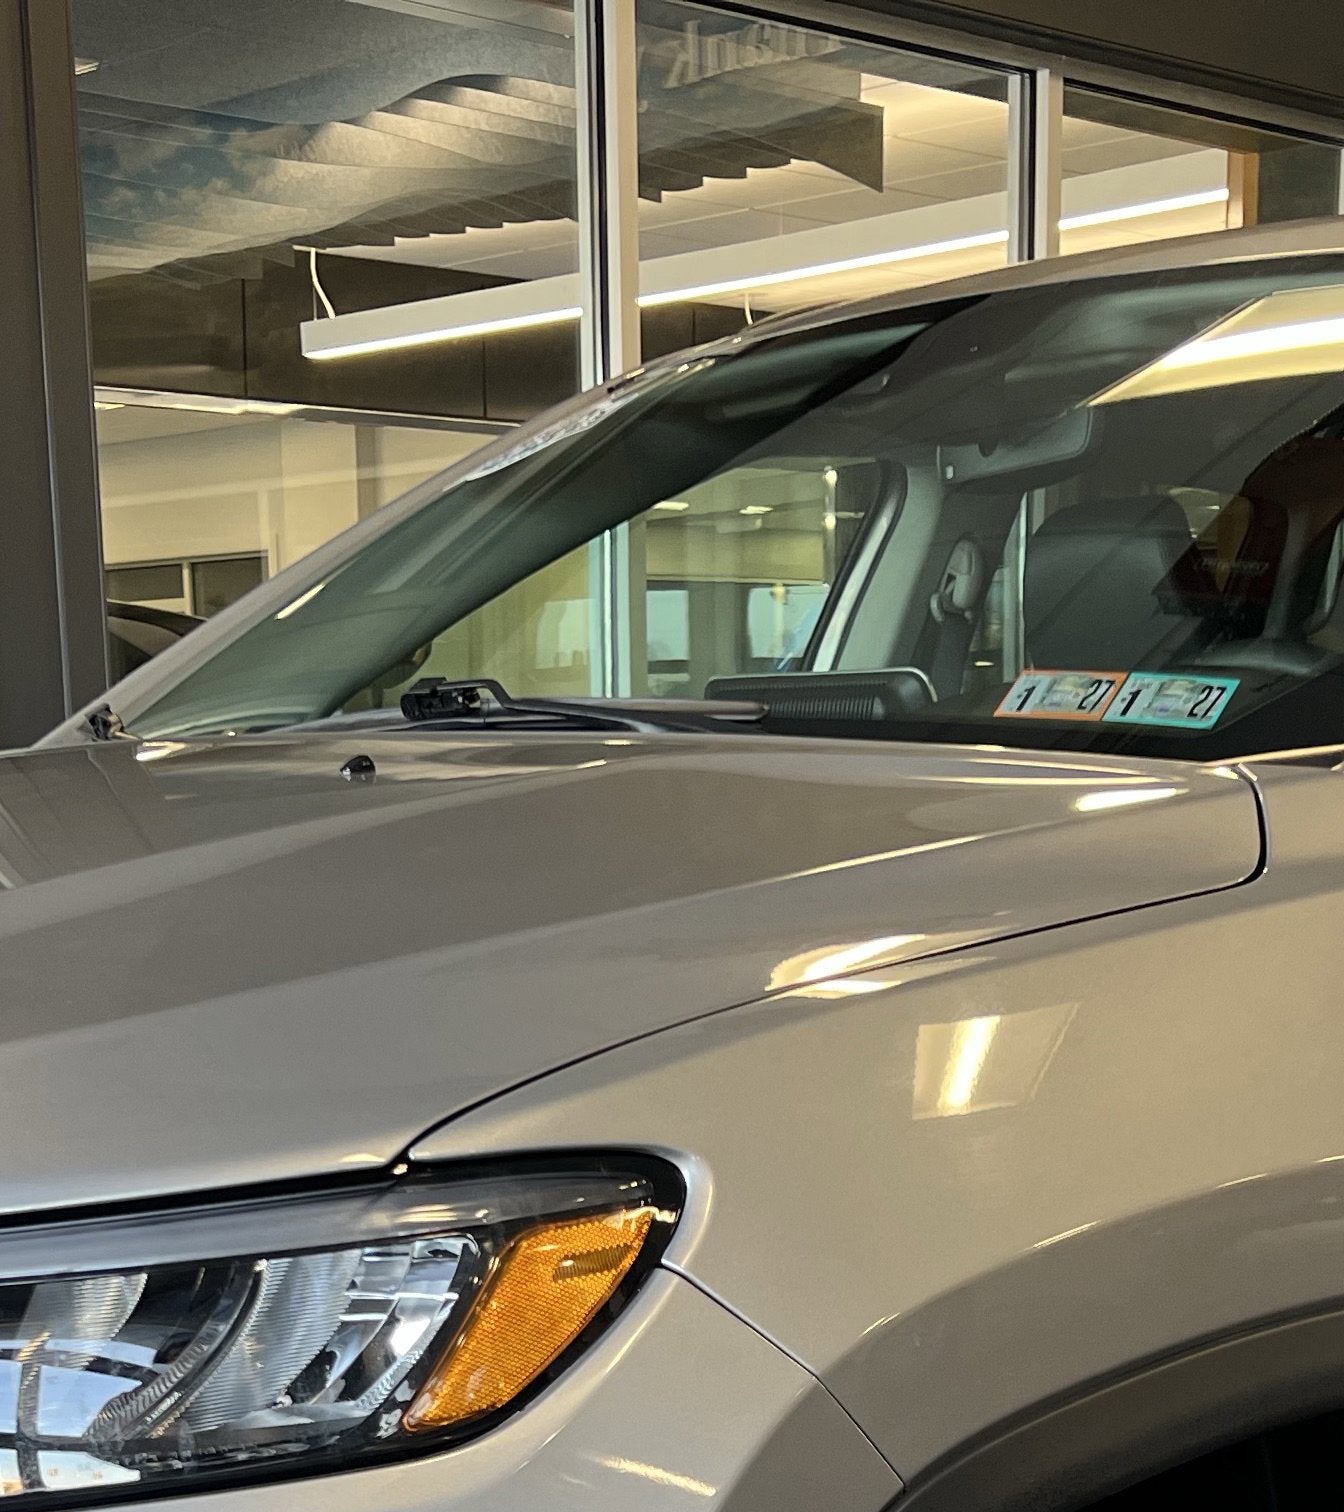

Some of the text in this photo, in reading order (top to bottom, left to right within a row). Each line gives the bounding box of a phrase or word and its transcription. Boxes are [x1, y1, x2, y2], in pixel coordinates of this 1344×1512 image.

[1016, 679, 1116, 713] 1 27
[1121, 686, 1227, 719] 1 27
